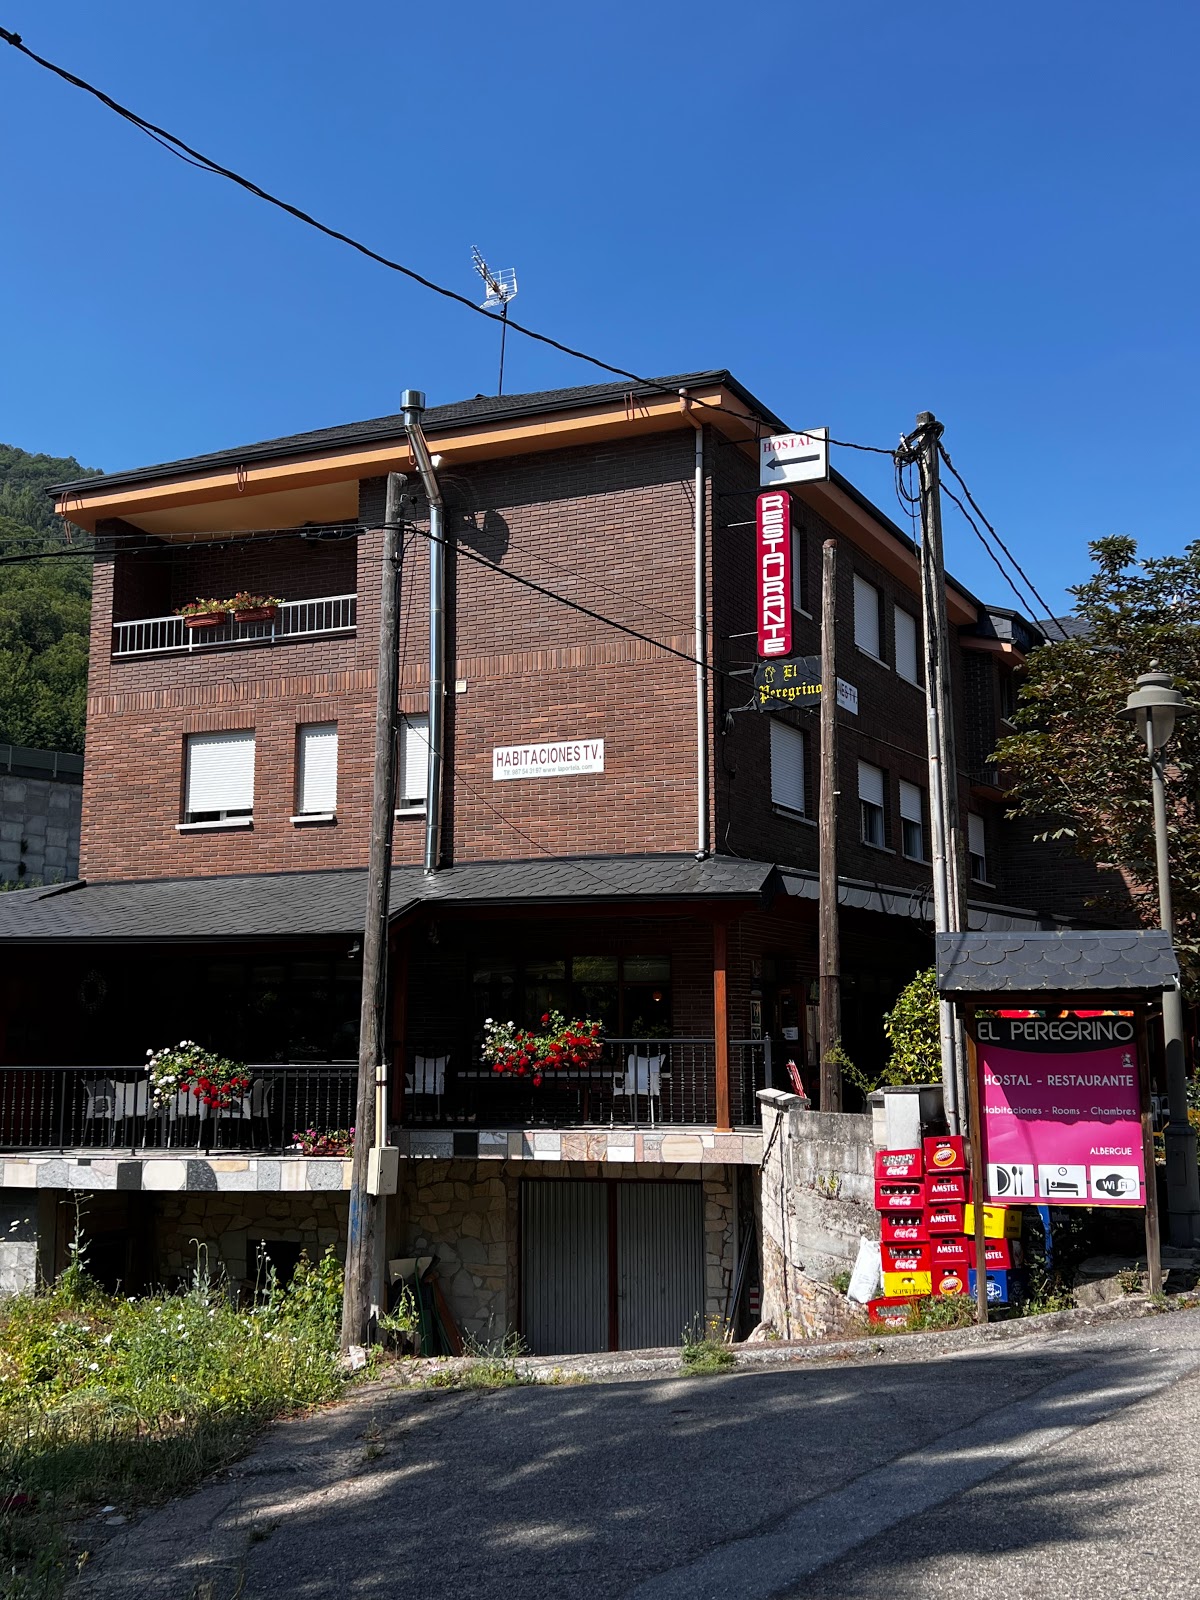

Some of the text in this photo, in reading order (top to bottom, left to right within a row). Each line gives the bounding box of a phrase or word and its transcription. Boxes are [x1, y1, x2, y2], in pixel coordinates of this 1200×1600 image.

[763, 435, 813, 452] HOSTAL
[761, 495, 785, 653] RESTAURANTE
[783, 665, 797, 681] El
[759, 682, 823, 704] Peregrino
[496, 745, 581, 767] HABITACIONES
[977, 1021, 1134, 1041] EL PEREGRINO
[984, 1074, 1032, 1086] HOSTAL
[1047, 1074, 1134, 1087] RESTAURANTE
[983, 1105, 1042, 1115] Habitaciones
[1052, 1106, 1080, 1115] Rooms
[1090, 1106, 1136, 1116] Chambres
[1090, 1147, 1133, 1156] ALBERGUE
[931, 1184, 959, 1193] AMSTEL
[929, 1214, 957, 1223] AMSTEL
[936, 1245, 964, 1254] AMSTEL
